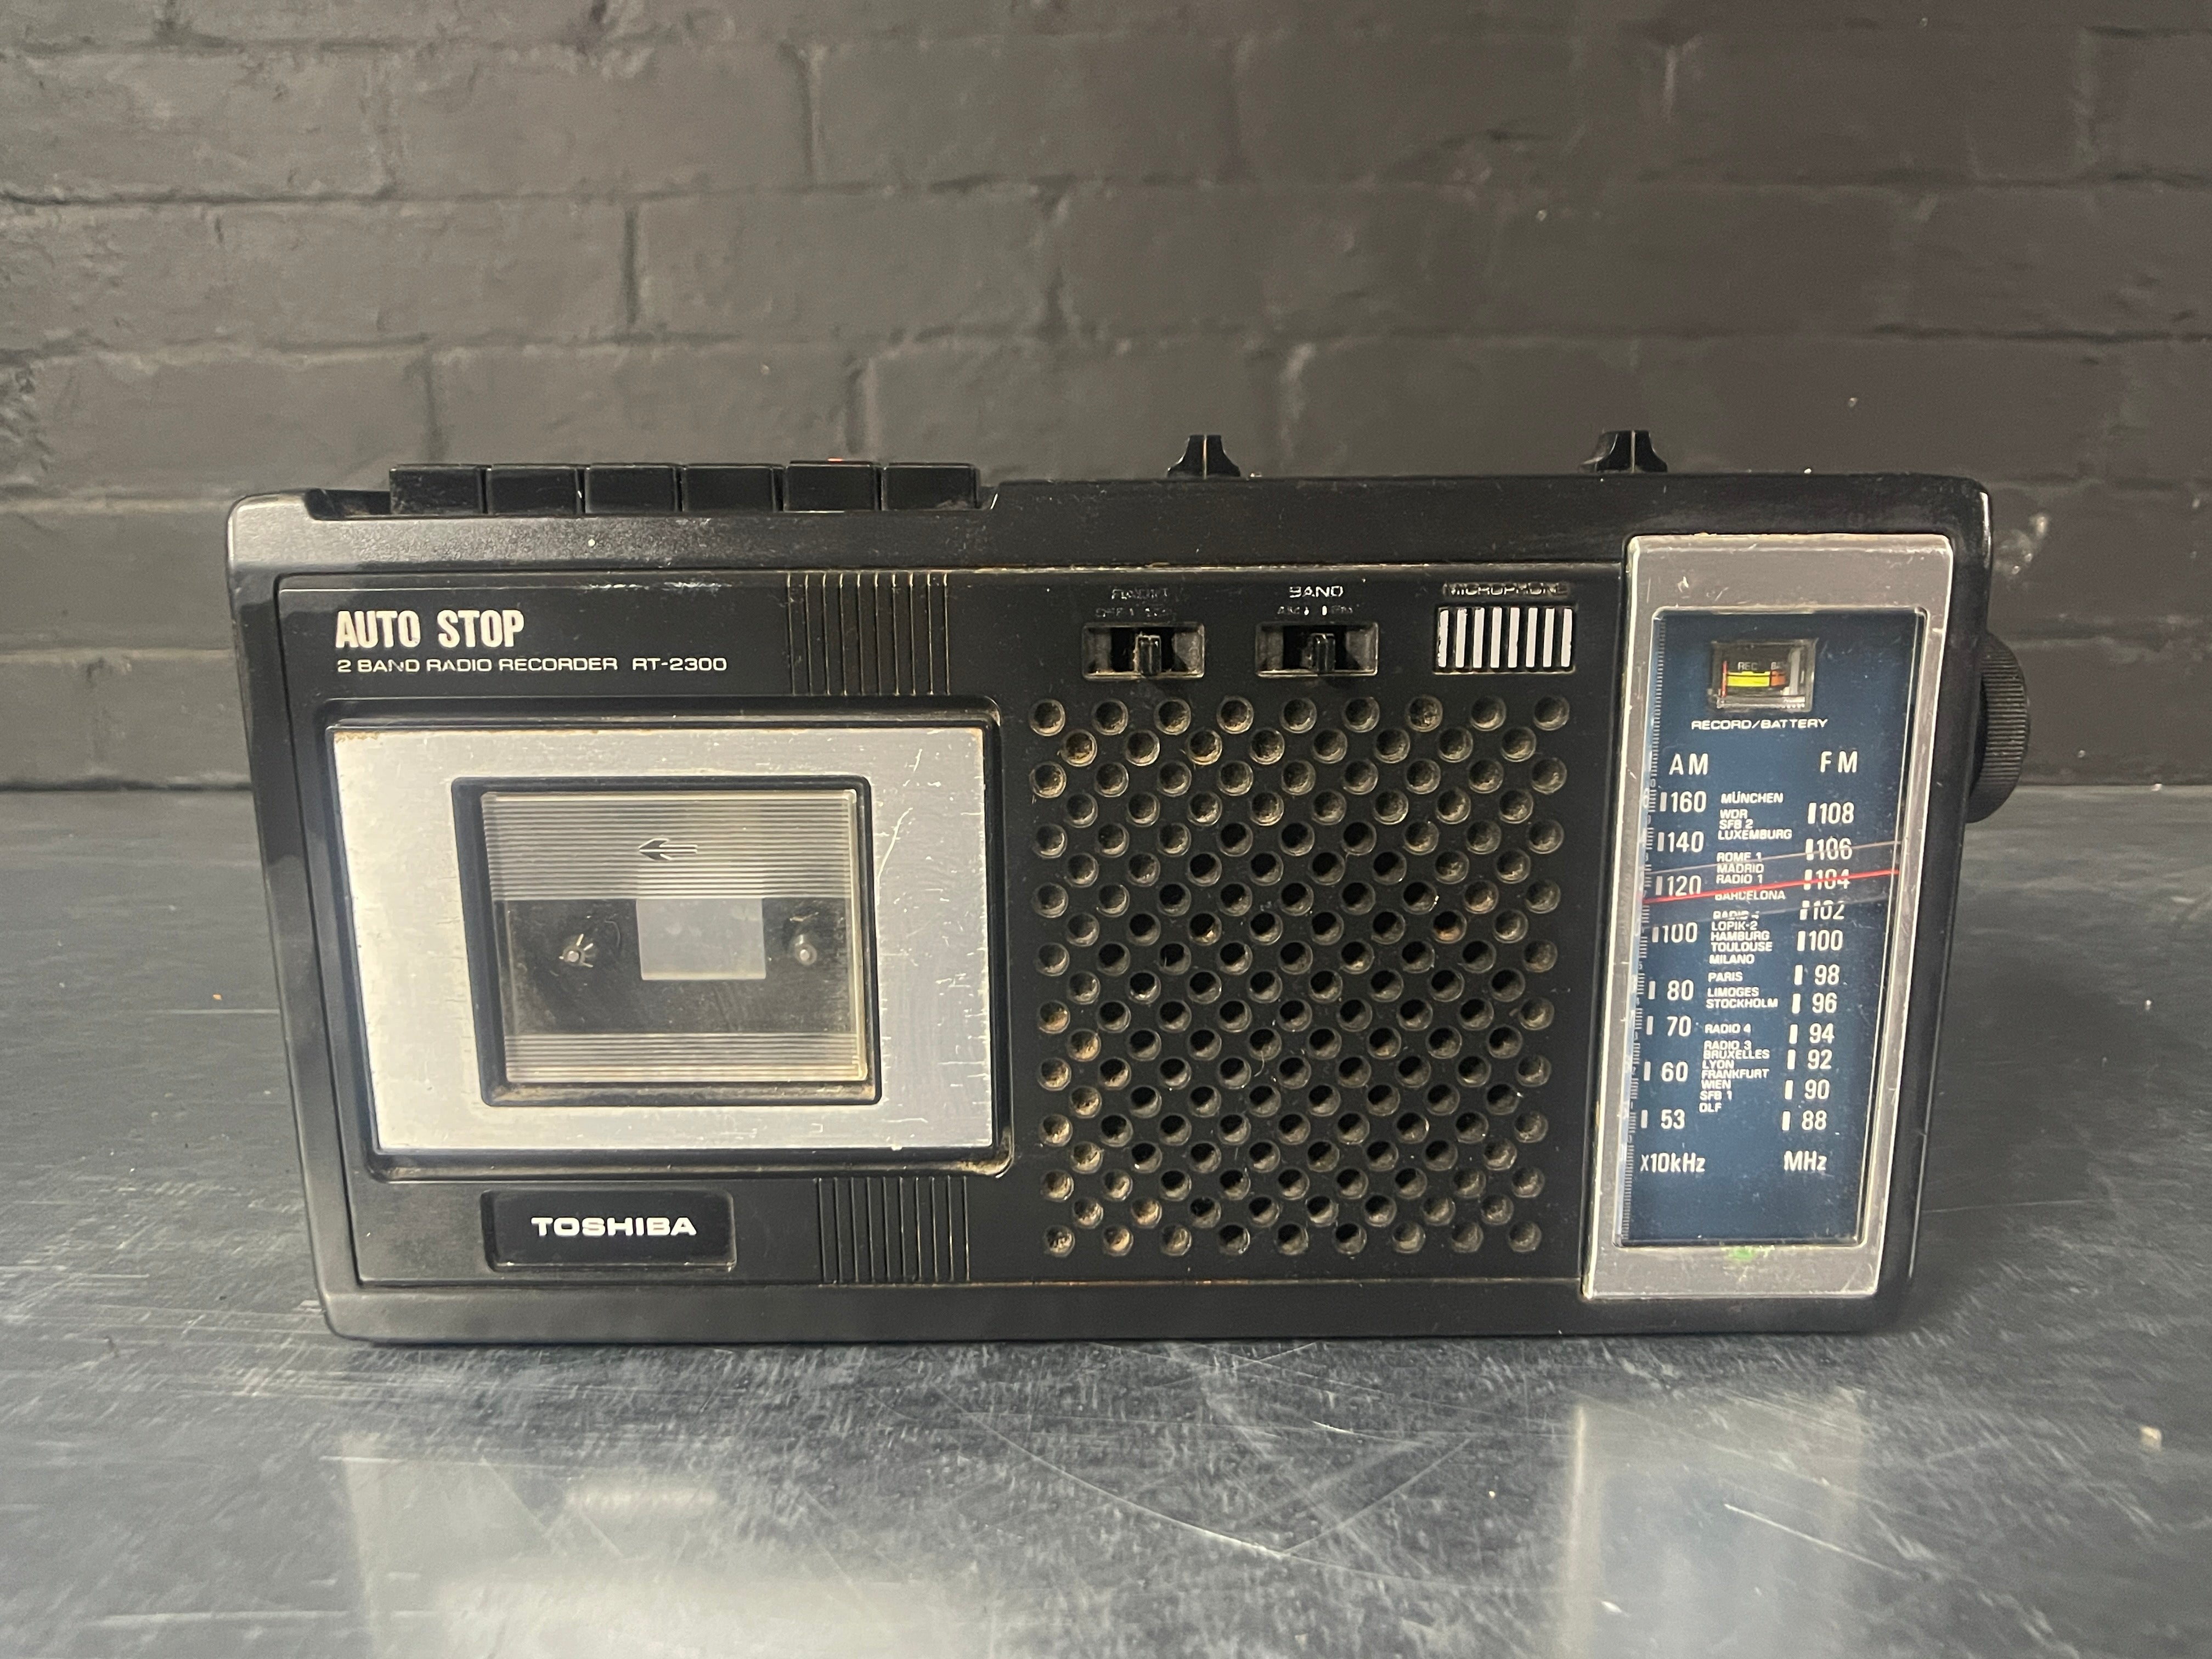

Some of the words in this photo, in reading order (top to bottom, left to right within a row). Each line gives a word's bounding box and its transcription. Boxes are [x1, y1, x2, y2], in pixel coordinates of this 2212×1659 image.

[1289, 585, 1344, 598] BAND
[335, 610, 421, 649] AUTO
[438, 610, 525, 649] STOP
[337, 659, 352, 673] 2
[358, 659, 420, 673] BAND
[426, 659, 492, 673] RADIO
[499, 658, 618, 672] RECORDER
[632, 658, 727, 672] RT-2300
[1737, 661, 1758, 670] REC
[1691, 719, 1828, 730] RECORD/BATTERY
[1669, 754, 1708, 775] AM
[1820, 751, 1858, 772] FM
[1671, 791, 1707, 812] 160
[1720, 791, 1784, 804] MÜNCHEN
[1719, 809, 1748, 819] WDR
[1820, 802, 1854, 823] 108
[1719, 819, 1742, 830] SFB
[1745, 819, 1754, 829] 2
[1718, 829, 1793, 840] LUXEMBURG
[1667, 831, 1704, 853] 140
[1816, 837, 1853, 860] 106
[1716, 852, 1752, 862] ROME
[1756, 852, 1762, 862] 1
[1717, 864, 1764, 873] MADRID
[1716, 874, 1753, 884] RADIO
[1757, 874, 1763, 884] 1
[1816, 868, 1850, 890] 104
[1667, 876, 1702, 896] 120
[1714, 889, 1787, 901] BARCELONA
[1813, 900, 1845, 921] 102
[1662, 922, 1698, 943] 100
[1711, 921, 1758, 931] LOPIK-2
[1710, 930, 1770, 941] HAMBURG
[1809, 930, 1843, 951] 100
[1711, 941, 1773, 952] TOULOUSE
[1709, 953, 1755, 964] MILANO
[1707, 972, 1743, 983] PARIS
[1814, 964, 1840, 985] 98
[1667, 979, 1694, 1001] 80
[1707, 986, 1759, 997] LIMOGES
[1706, 998, 1779, 1009] STOCKHOLM
[1812, 992, 1837, 1014] 96
[1667, 1015, 1691, 1037] 70
[1704, 1024, 1741, 1034] RADIO
[1742, 1023, 1751, 1034] 4
[1809, 1023, 1835, 1043] 94
[1703, 1040, 1740, 1050] RADIO
[1743, 1040, 1752, 1050] 3
[1703, 1049, 1770, 1059] BRUXELLES
[1808, 1049, 1832, 1070] 92
[1702, 1059, 1735, 1069] LYON
[1661, 1062, 1688, 1082] 60
[1701, 1069, 1770, 1079] FRANKFURT
[1701, 1079, 1732, 1090] WIEN
[1804, 1079, 1830, 1100] 90
[1699, 1090, 1722, 1101] SFB
[1726, 1090, 1733, 1101] 1
[1699, 1102, 1722, 1113] DLF
[1661, 1109, 1685, 1130] 53
[1801, 1111, 1827, 1131] 88
[1784, 1151, 1827, 1171] MHz
[531, 1217, 697, 1237] TOSHIBA
